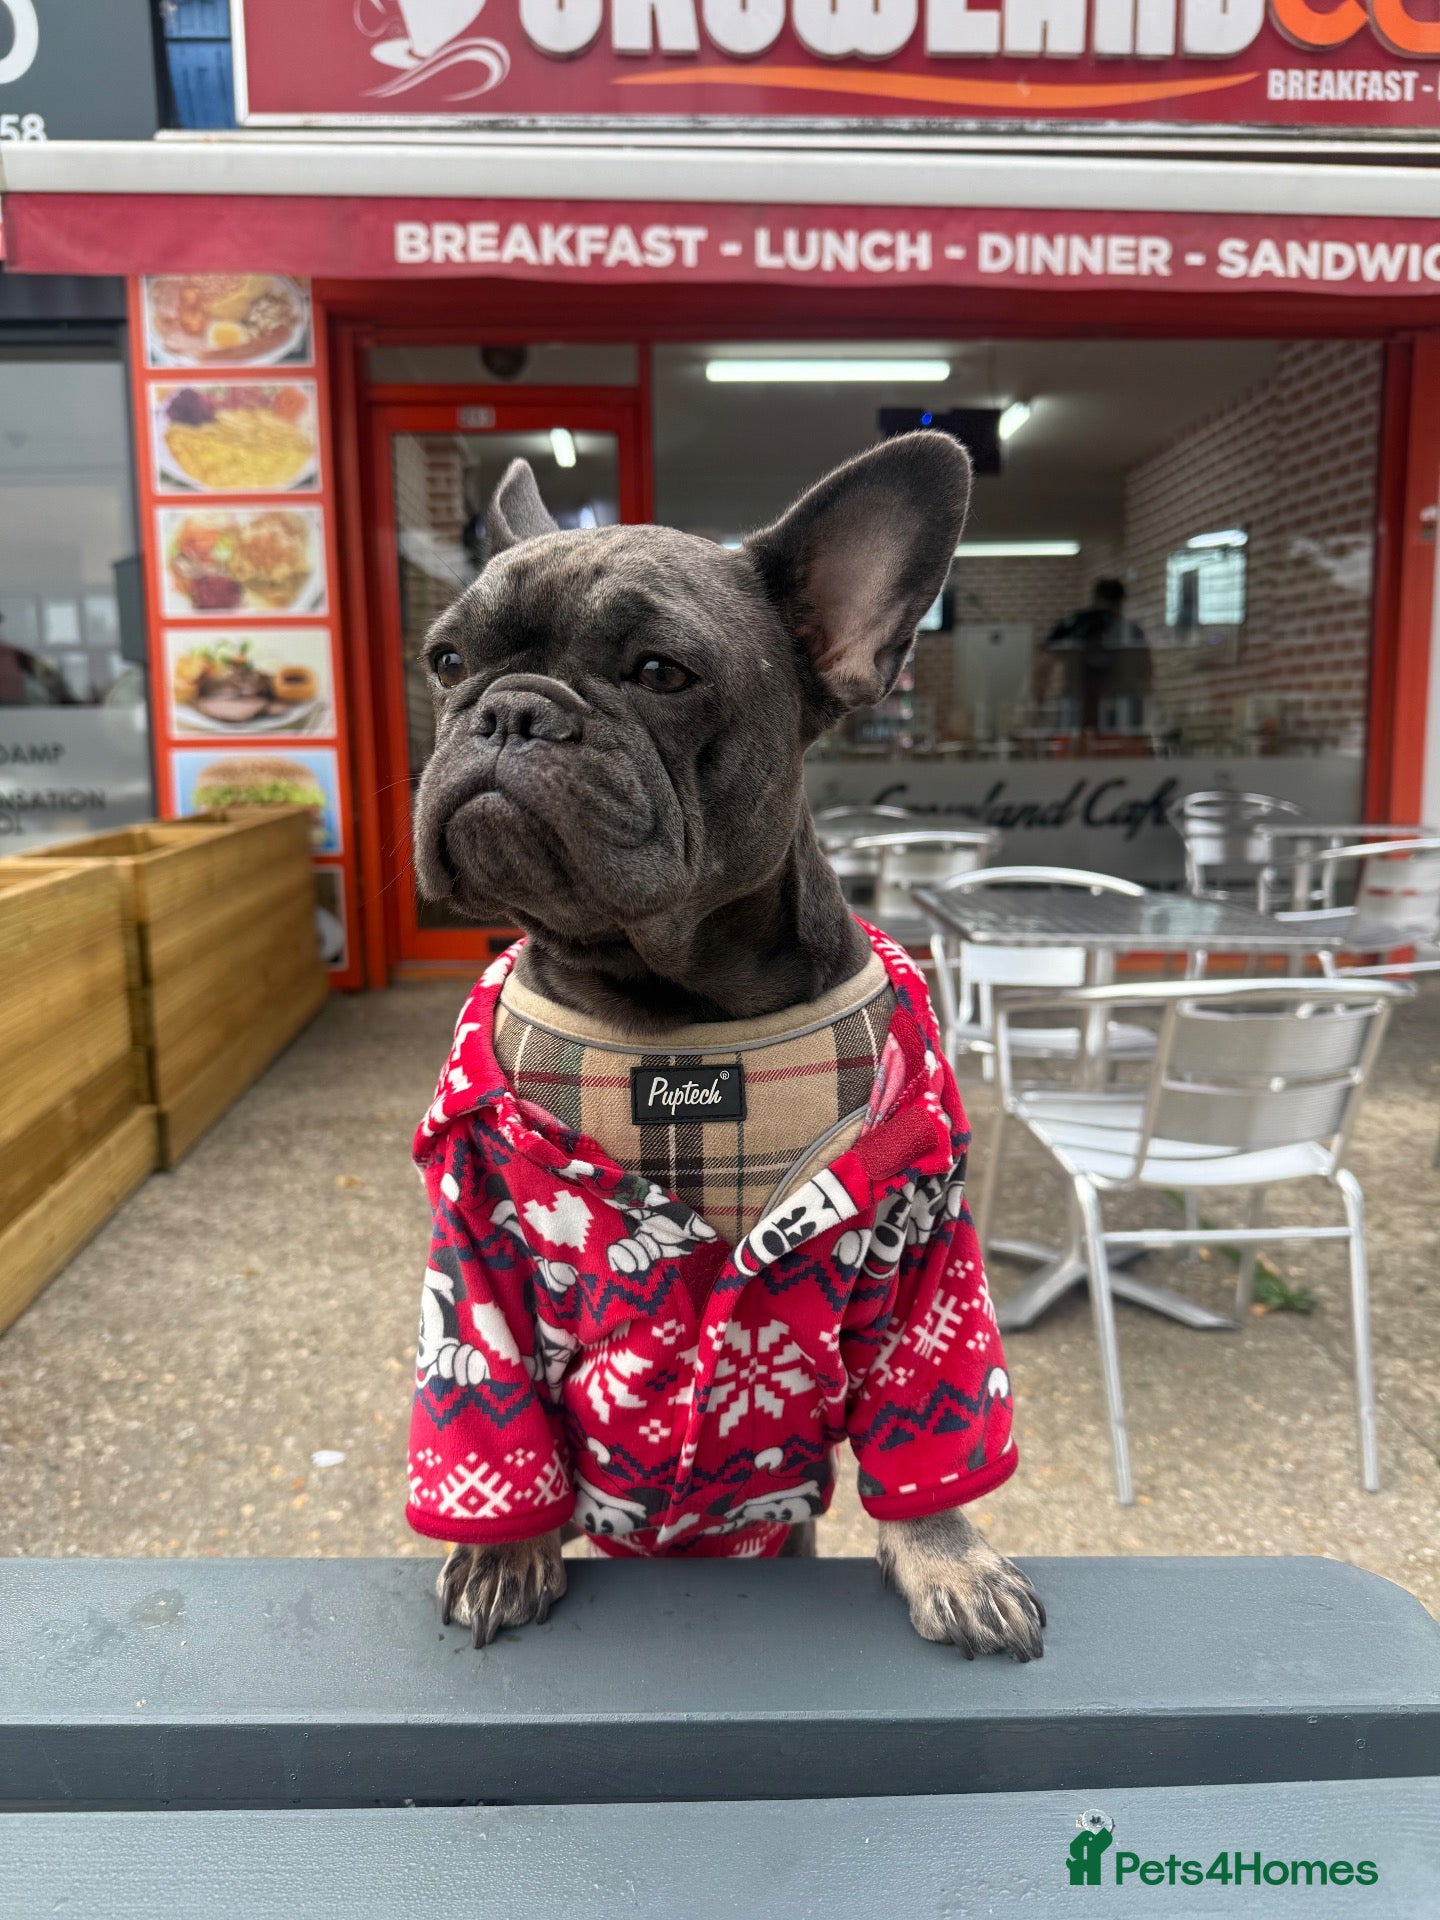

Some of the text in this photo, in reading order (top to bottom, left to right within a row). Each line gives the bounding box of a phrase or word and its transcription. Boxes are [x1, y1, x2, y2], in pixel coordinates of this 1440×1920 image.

[1267, 68, 1419, 101] BREAKFAST
[394, 221, 709, 268] BREAKFAST
[754, 227, 933, 272] LUNCH
[977, 232, 1173, 276] DINNER
[1082, 776, 1187, 842] Caf
